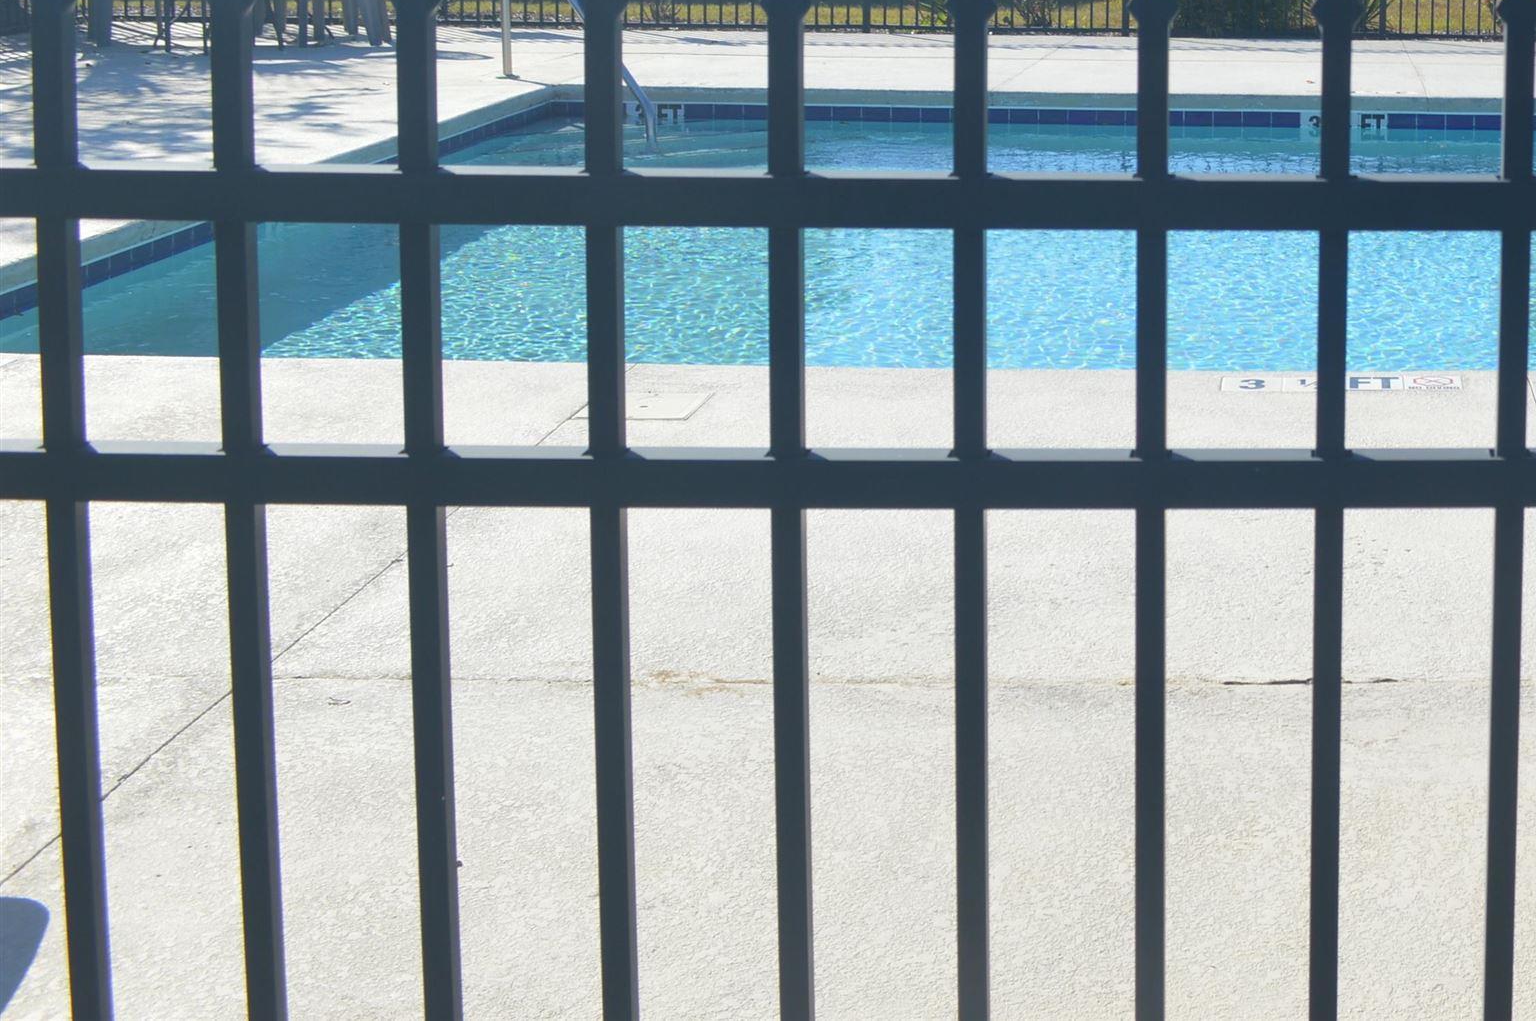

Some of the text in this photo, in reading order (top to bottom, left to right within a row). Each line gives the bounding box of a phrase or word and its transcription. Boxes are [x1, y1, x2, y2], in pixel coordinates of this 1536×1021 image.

[1361, 114, 1385, 129] FT
[1239, 378, 1265, 390] 3
[1349, 377, 1400, 390] FT
